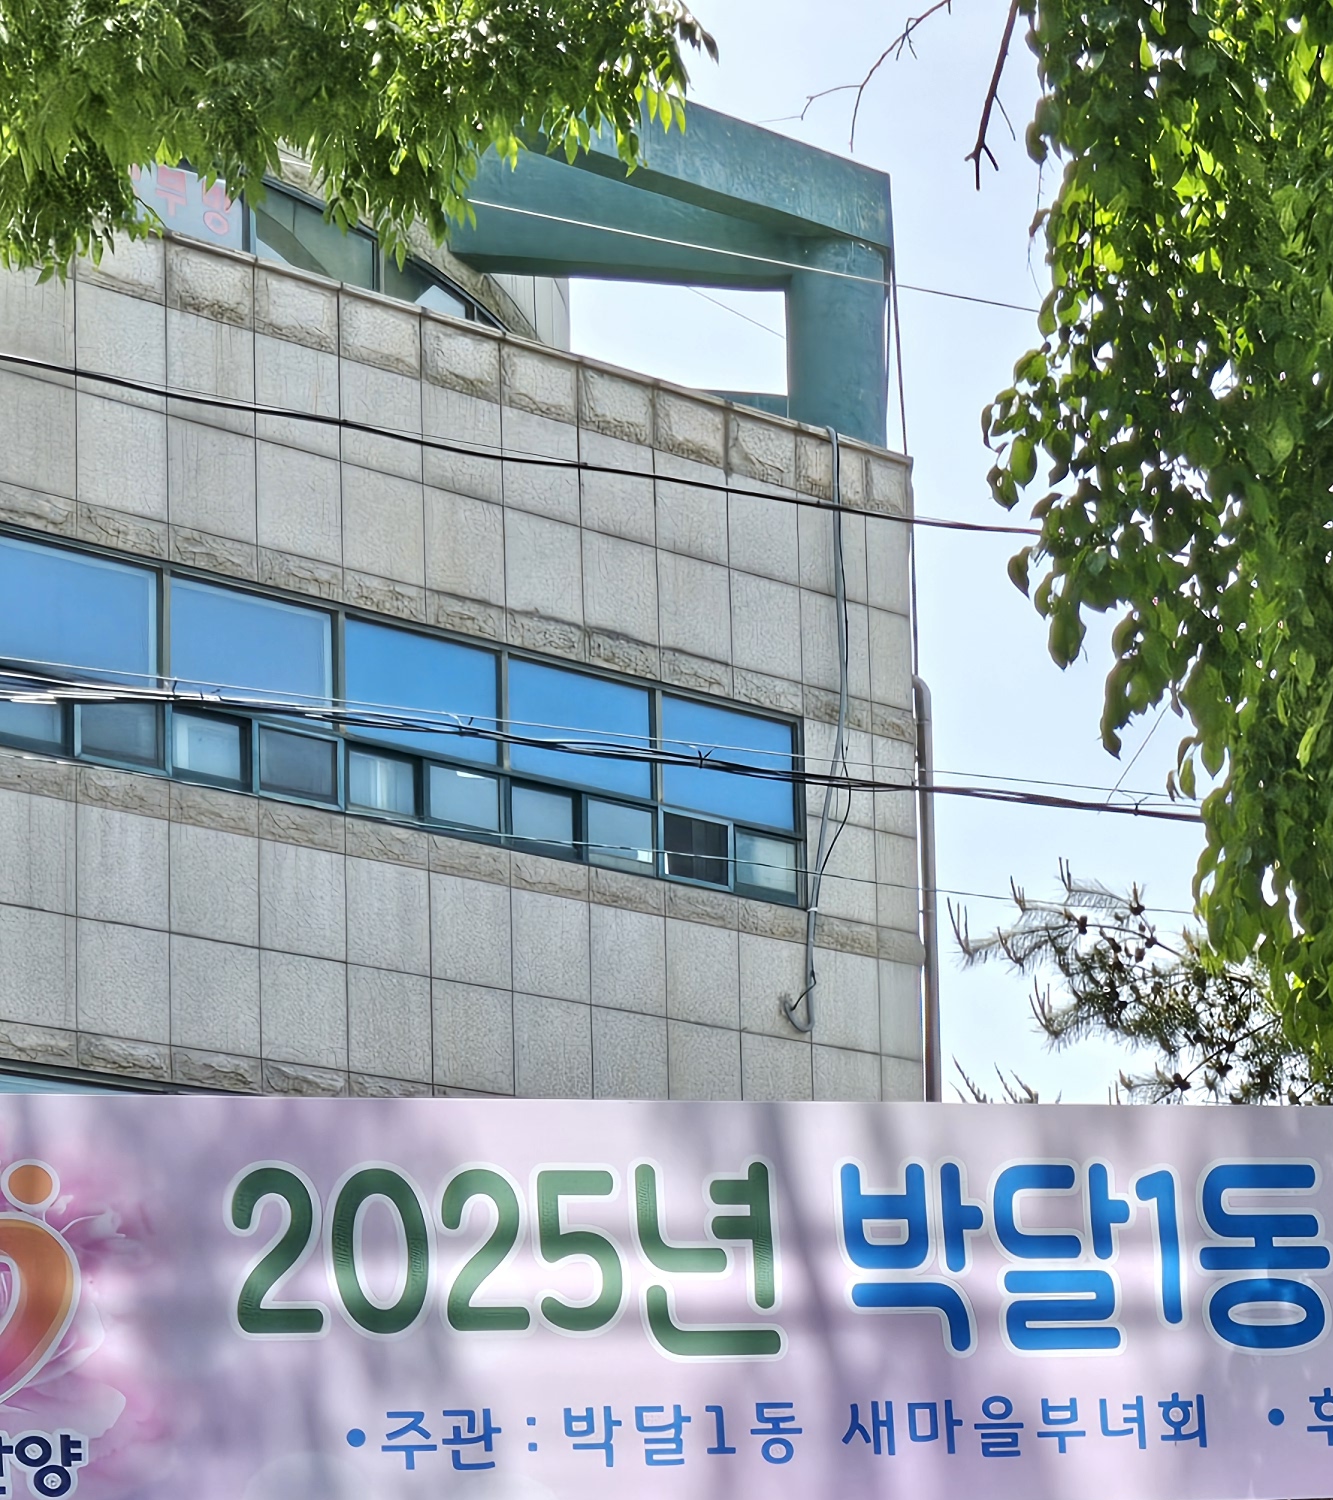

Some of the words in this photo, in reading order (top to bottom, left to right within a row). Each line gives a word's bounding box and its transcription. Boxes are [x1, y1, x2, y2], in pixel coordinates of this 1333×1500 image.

[229, 1159, 785, 1358] 2025년
[840, 1159, 1331, 1354] 박달1동
[563, 1402, 804, 1467] 박달1동
[843, 1391, 1210, 1459] 새마을부녀회
